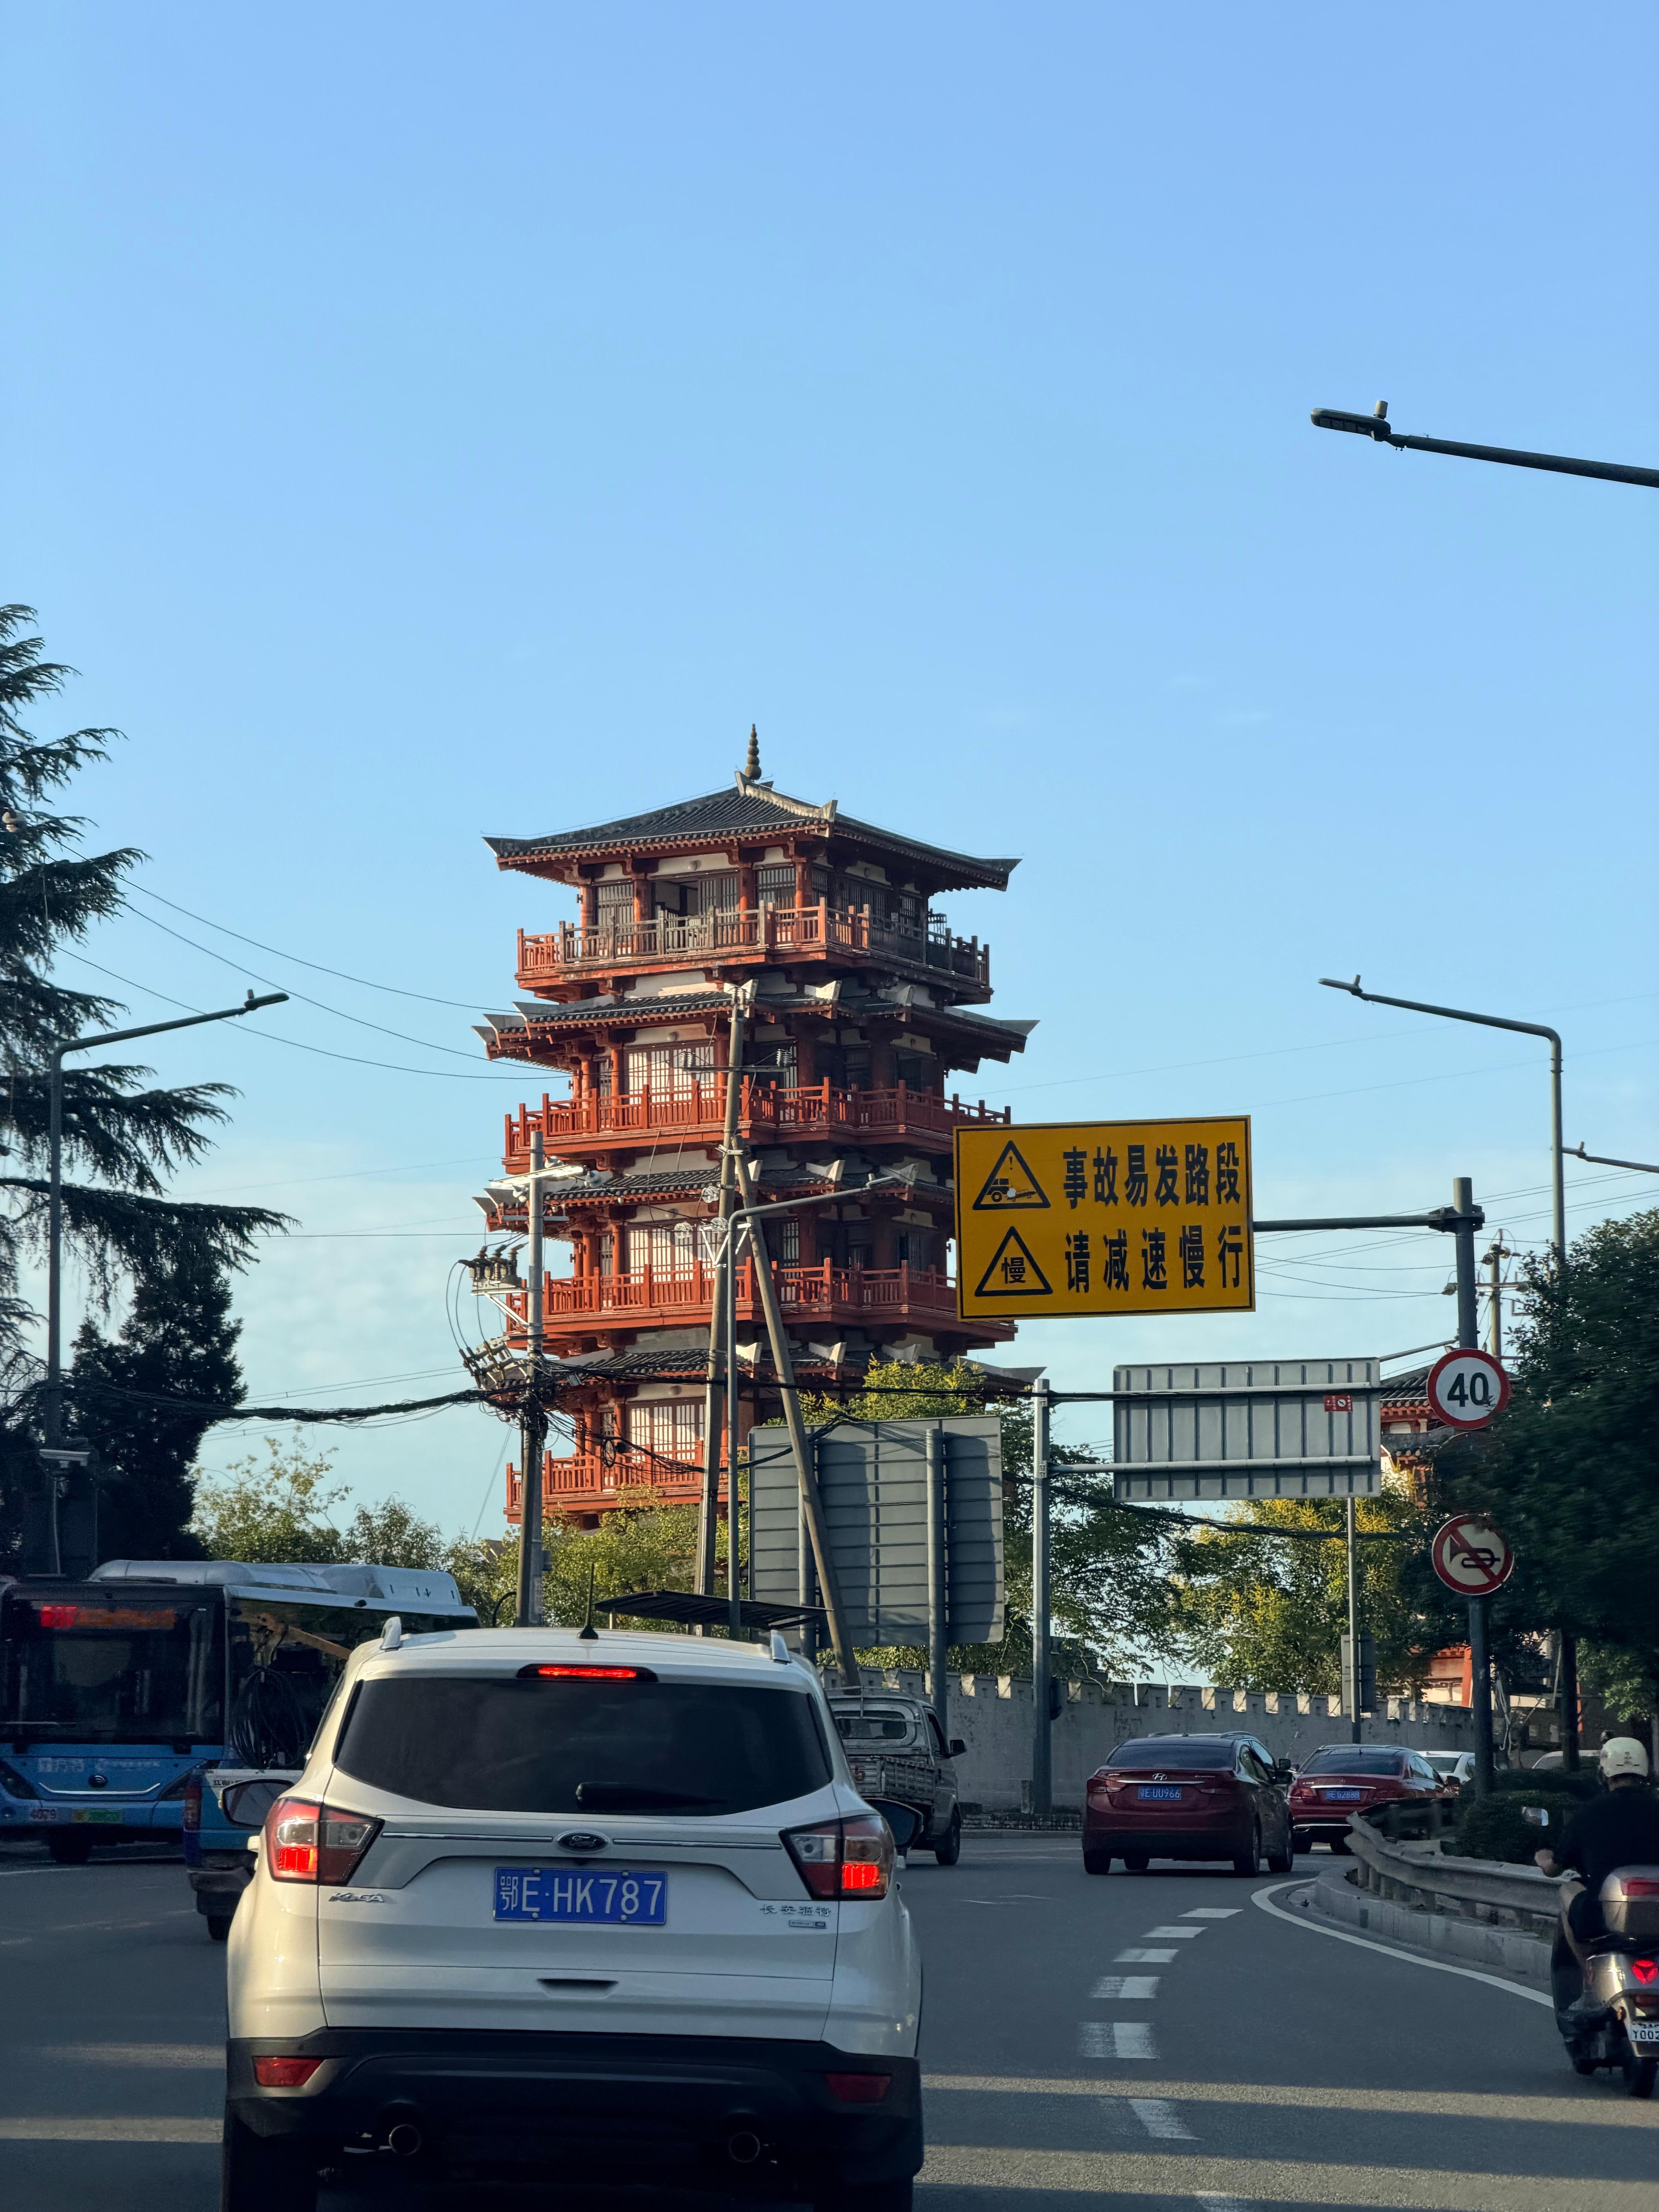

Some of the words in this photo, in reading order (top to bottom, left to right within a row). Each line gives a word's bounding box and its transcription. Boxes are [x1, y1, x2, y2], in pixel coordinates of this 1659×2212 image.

[1063, 1142, 1241, 1209] 事故易发路段
[1001, 1257, 1026, 1284] 慢
[1065, 1224, 1243, 1293] 请减速慢行
[1447, 1372, 1489, 1407] 40
[569, 1835, 597, 1847] Ford
